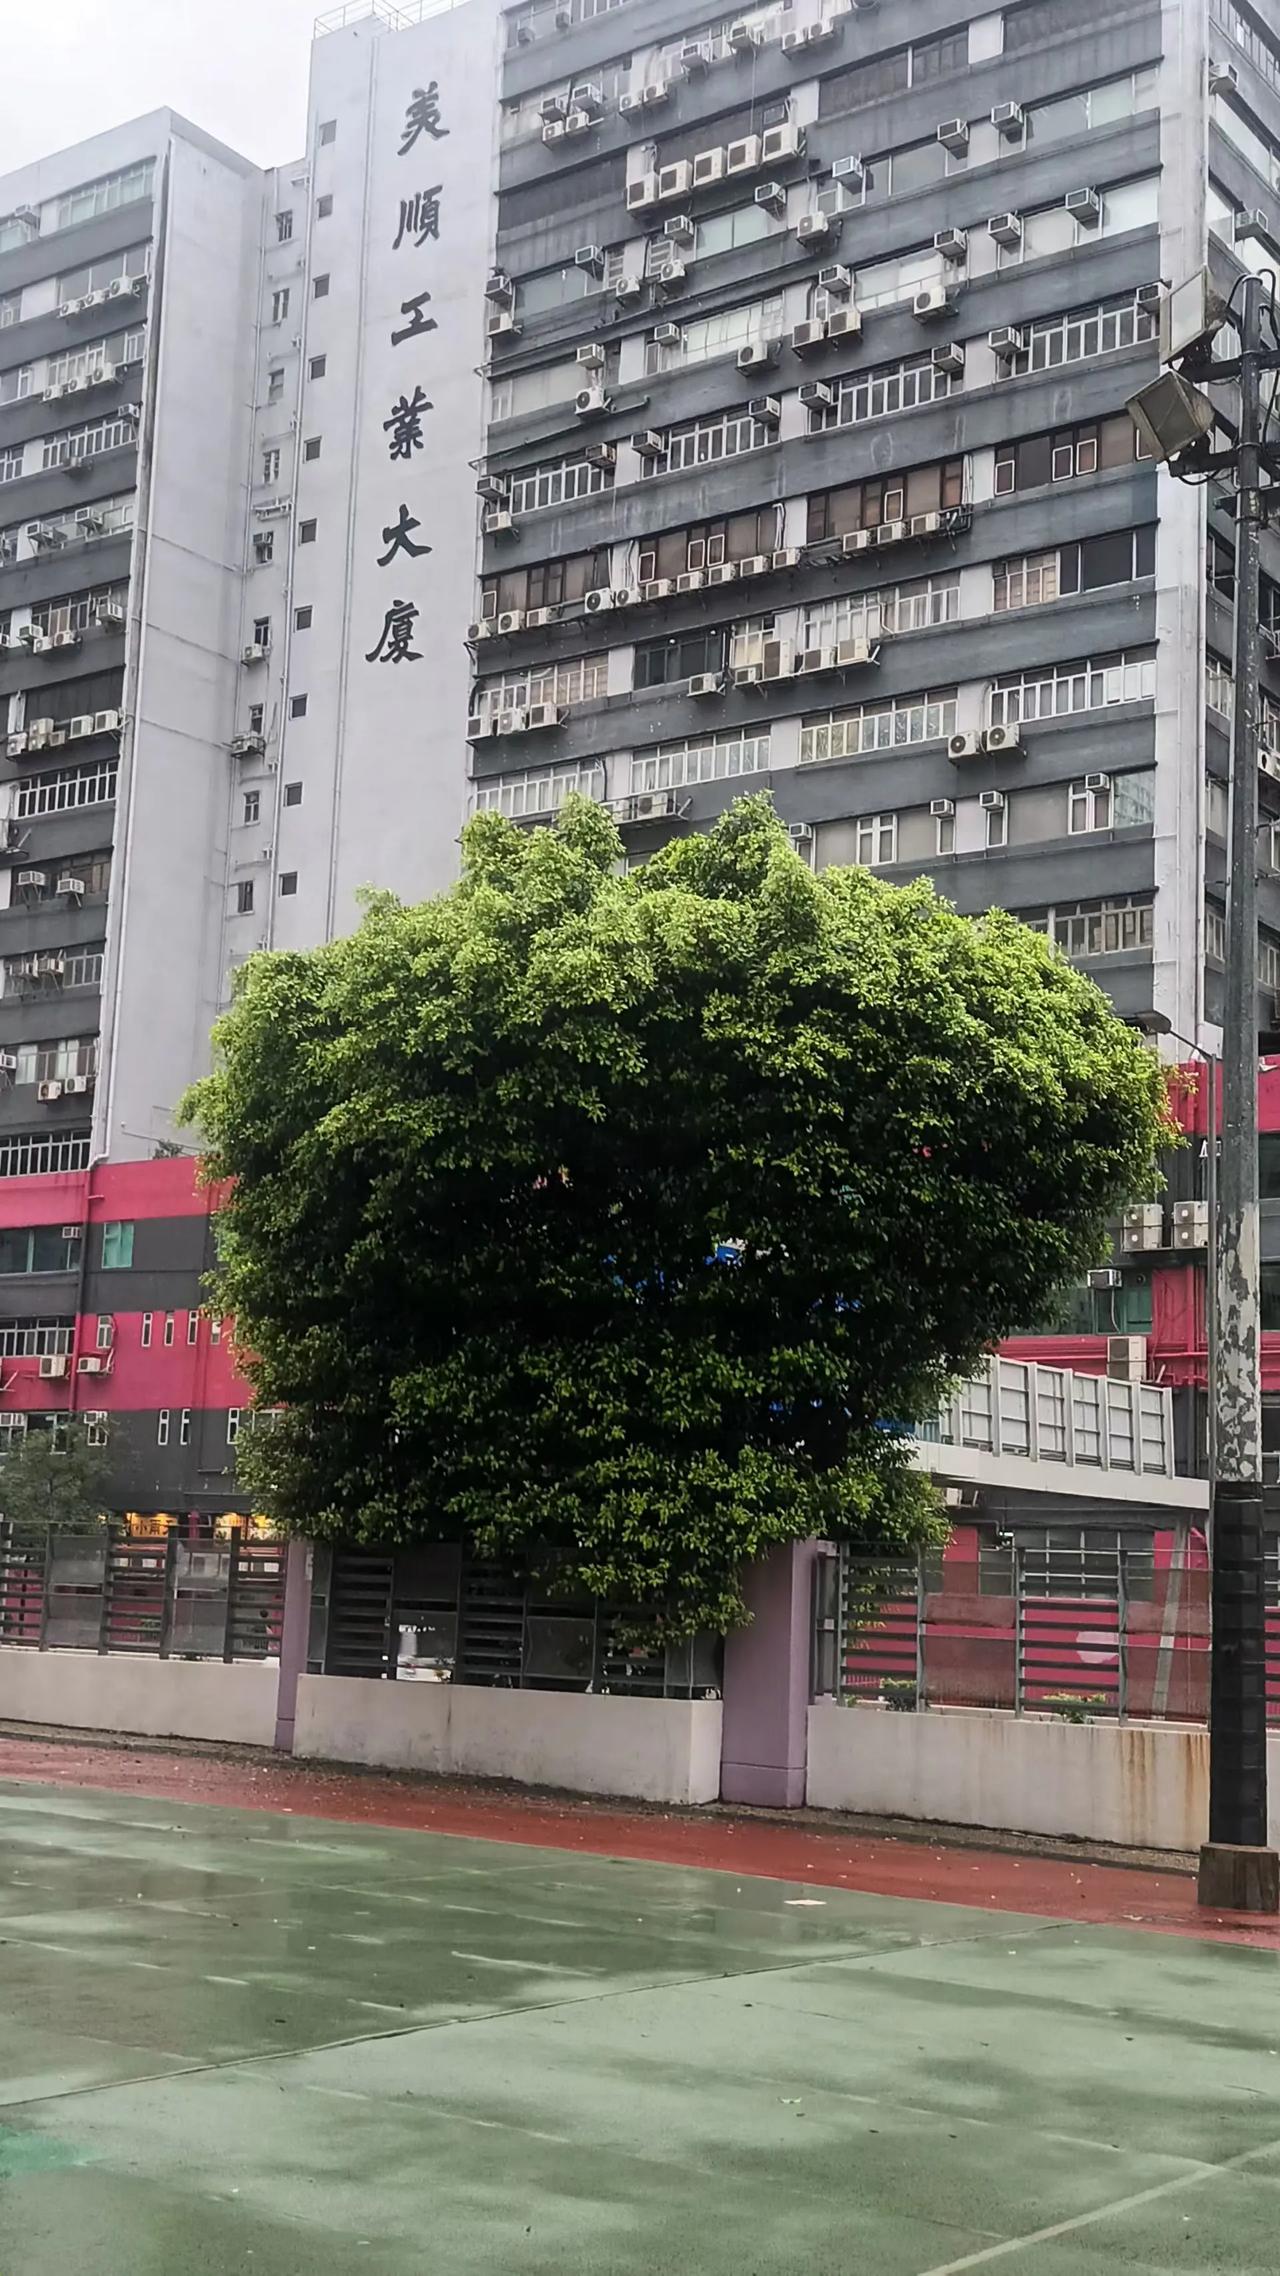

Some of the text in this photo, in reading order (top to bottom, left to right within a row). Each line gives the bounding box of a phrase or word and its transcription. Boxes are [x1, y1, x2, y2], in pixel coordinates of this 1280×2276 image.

[365, 81, 450, 663] 美順工業大廈
